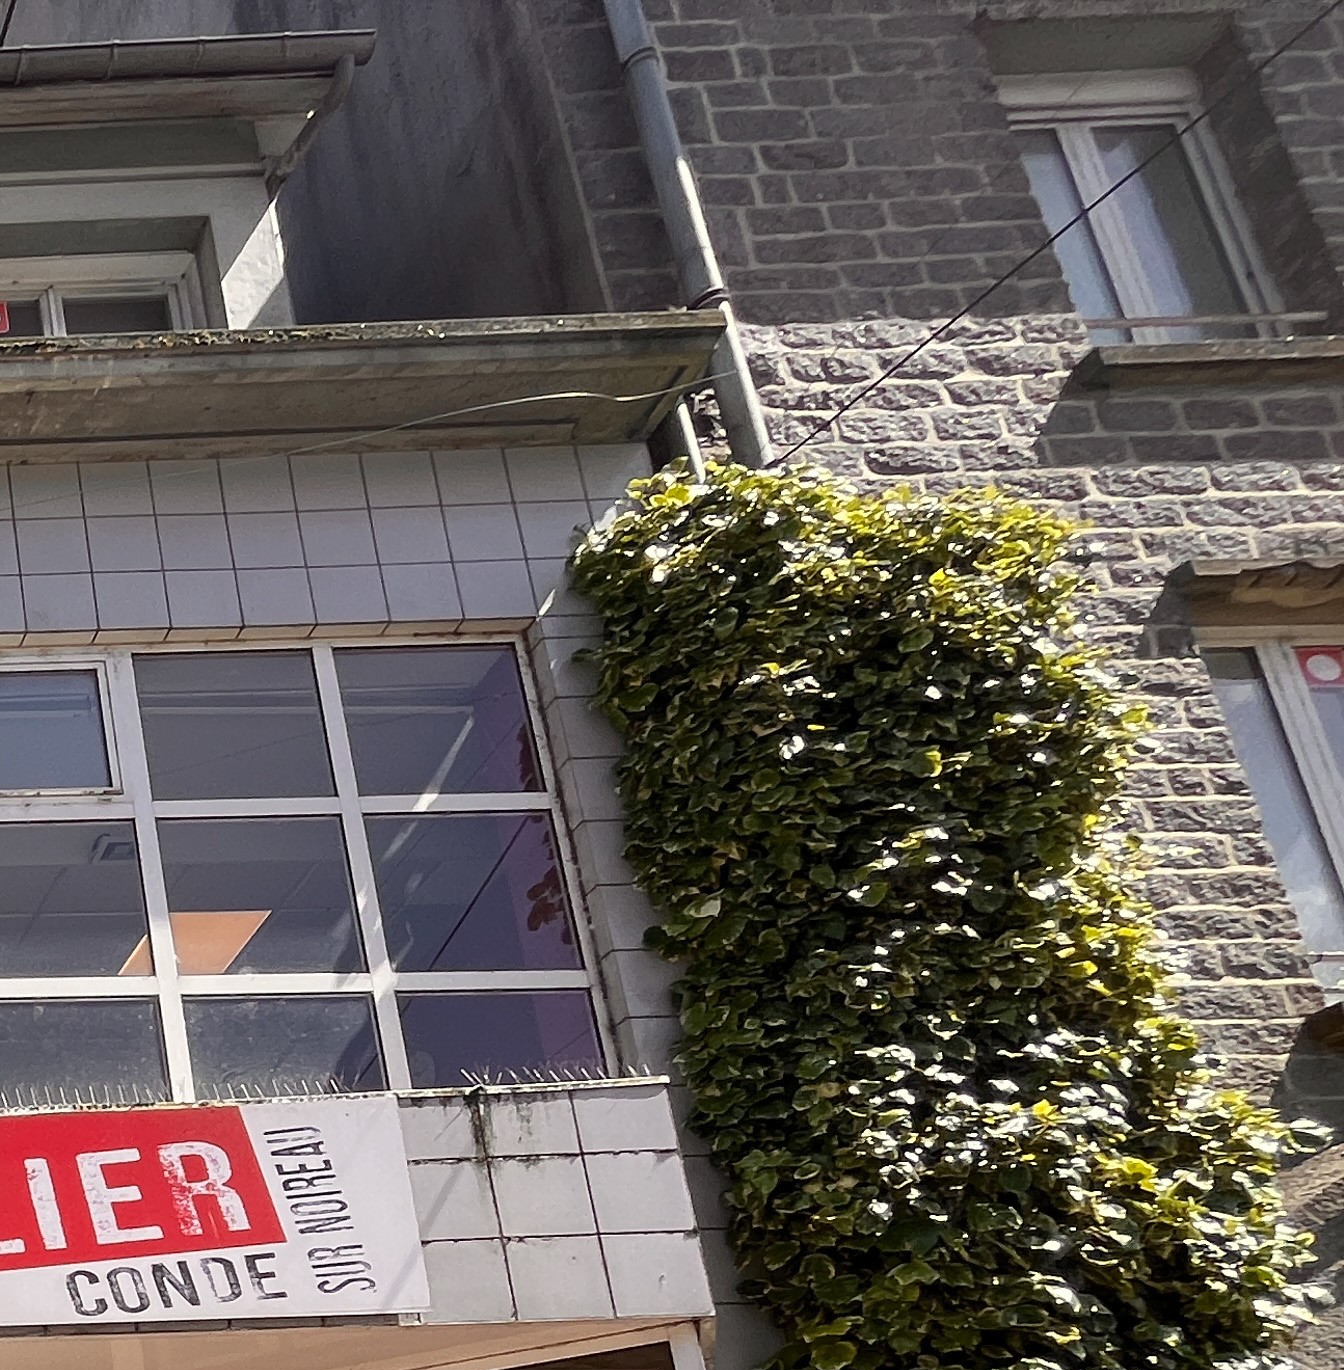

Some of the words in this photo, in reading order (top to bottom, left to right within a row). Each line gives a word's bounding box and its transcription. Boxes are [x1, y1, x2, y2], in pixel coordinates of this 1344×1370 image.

[262, 1126, 355, 1235] NOIREAU
[65, 1251, 289, 1317] CONDE
[307, 1243, 377, 1295] SUR
